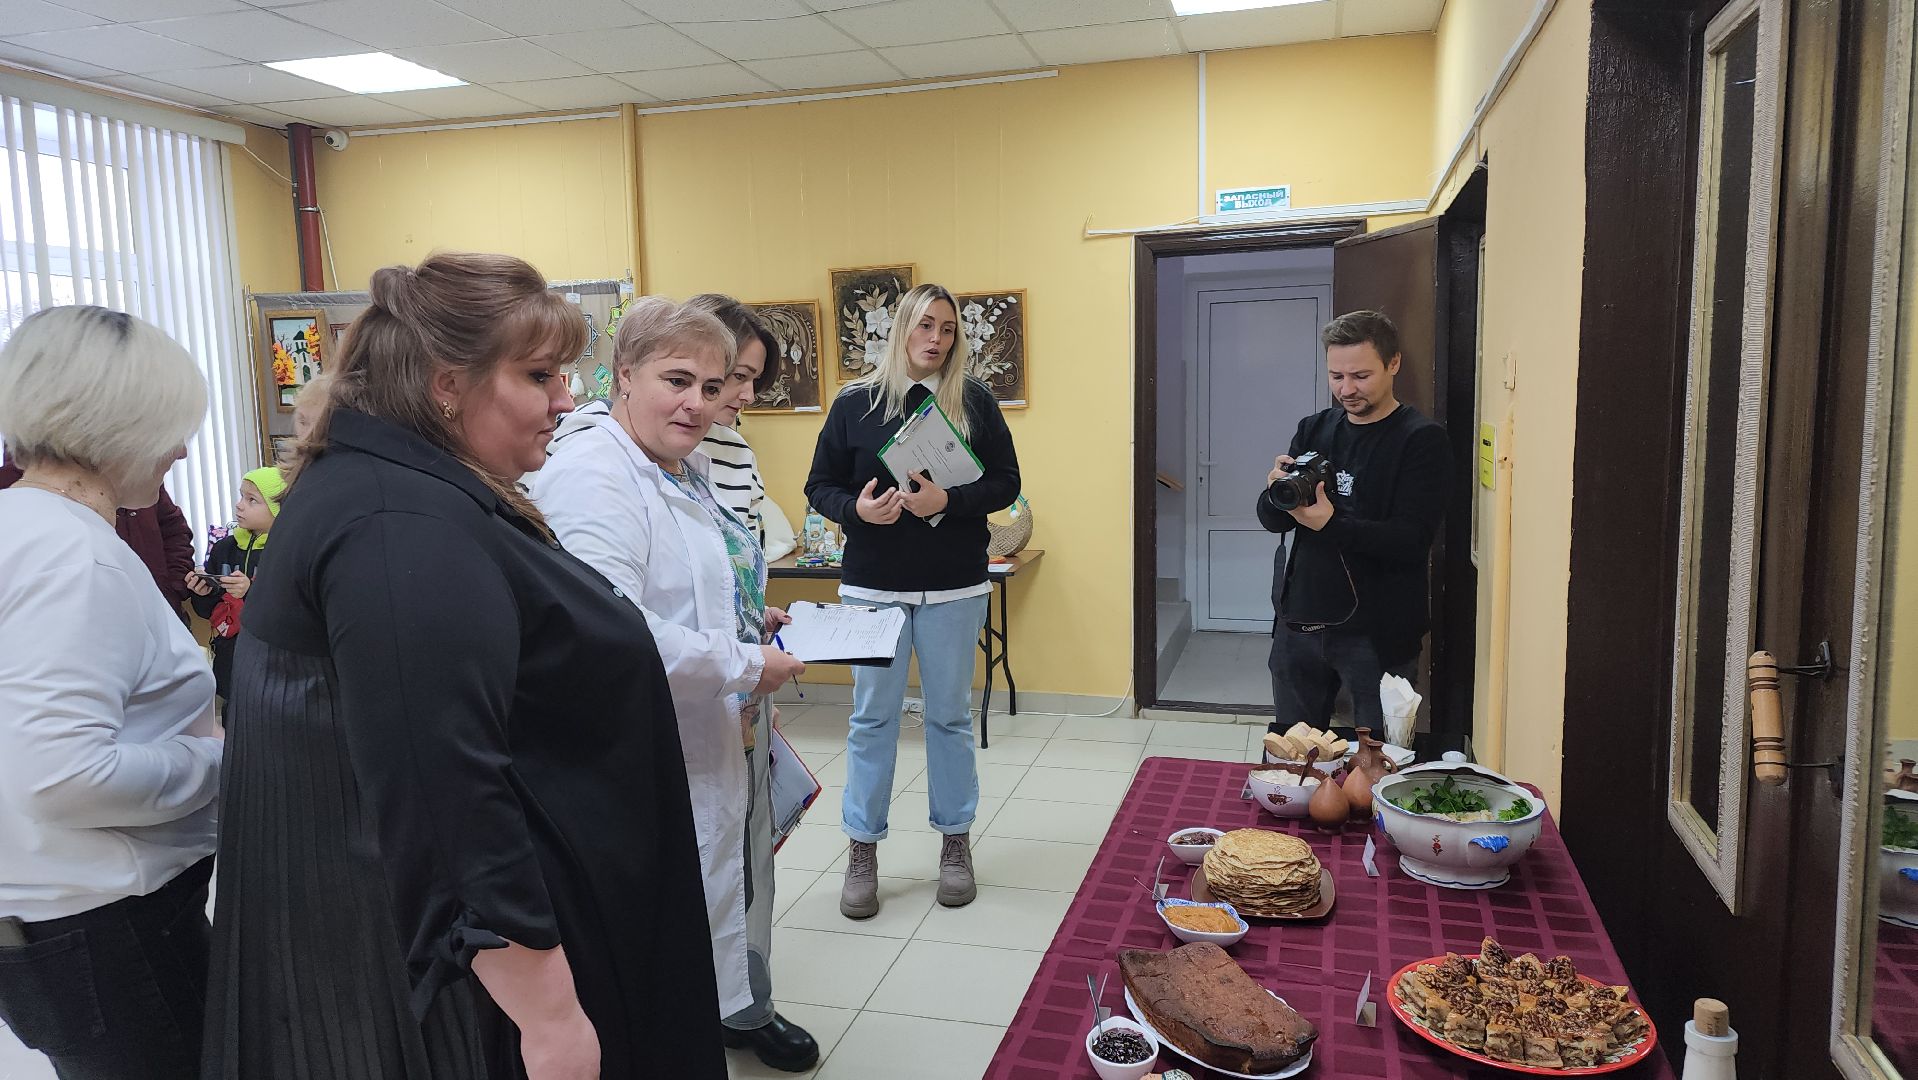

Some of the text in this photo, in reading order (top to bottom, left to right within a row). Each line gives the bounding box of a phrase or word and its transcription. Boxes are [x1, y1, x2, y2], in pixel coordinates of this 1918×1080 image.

[1223, 189, 1284, 202] ЗАПАСНЫЙ
[1234, 198, 1272, 209] ВЫХОД
[1301, 624, 1325, 632] Canon
